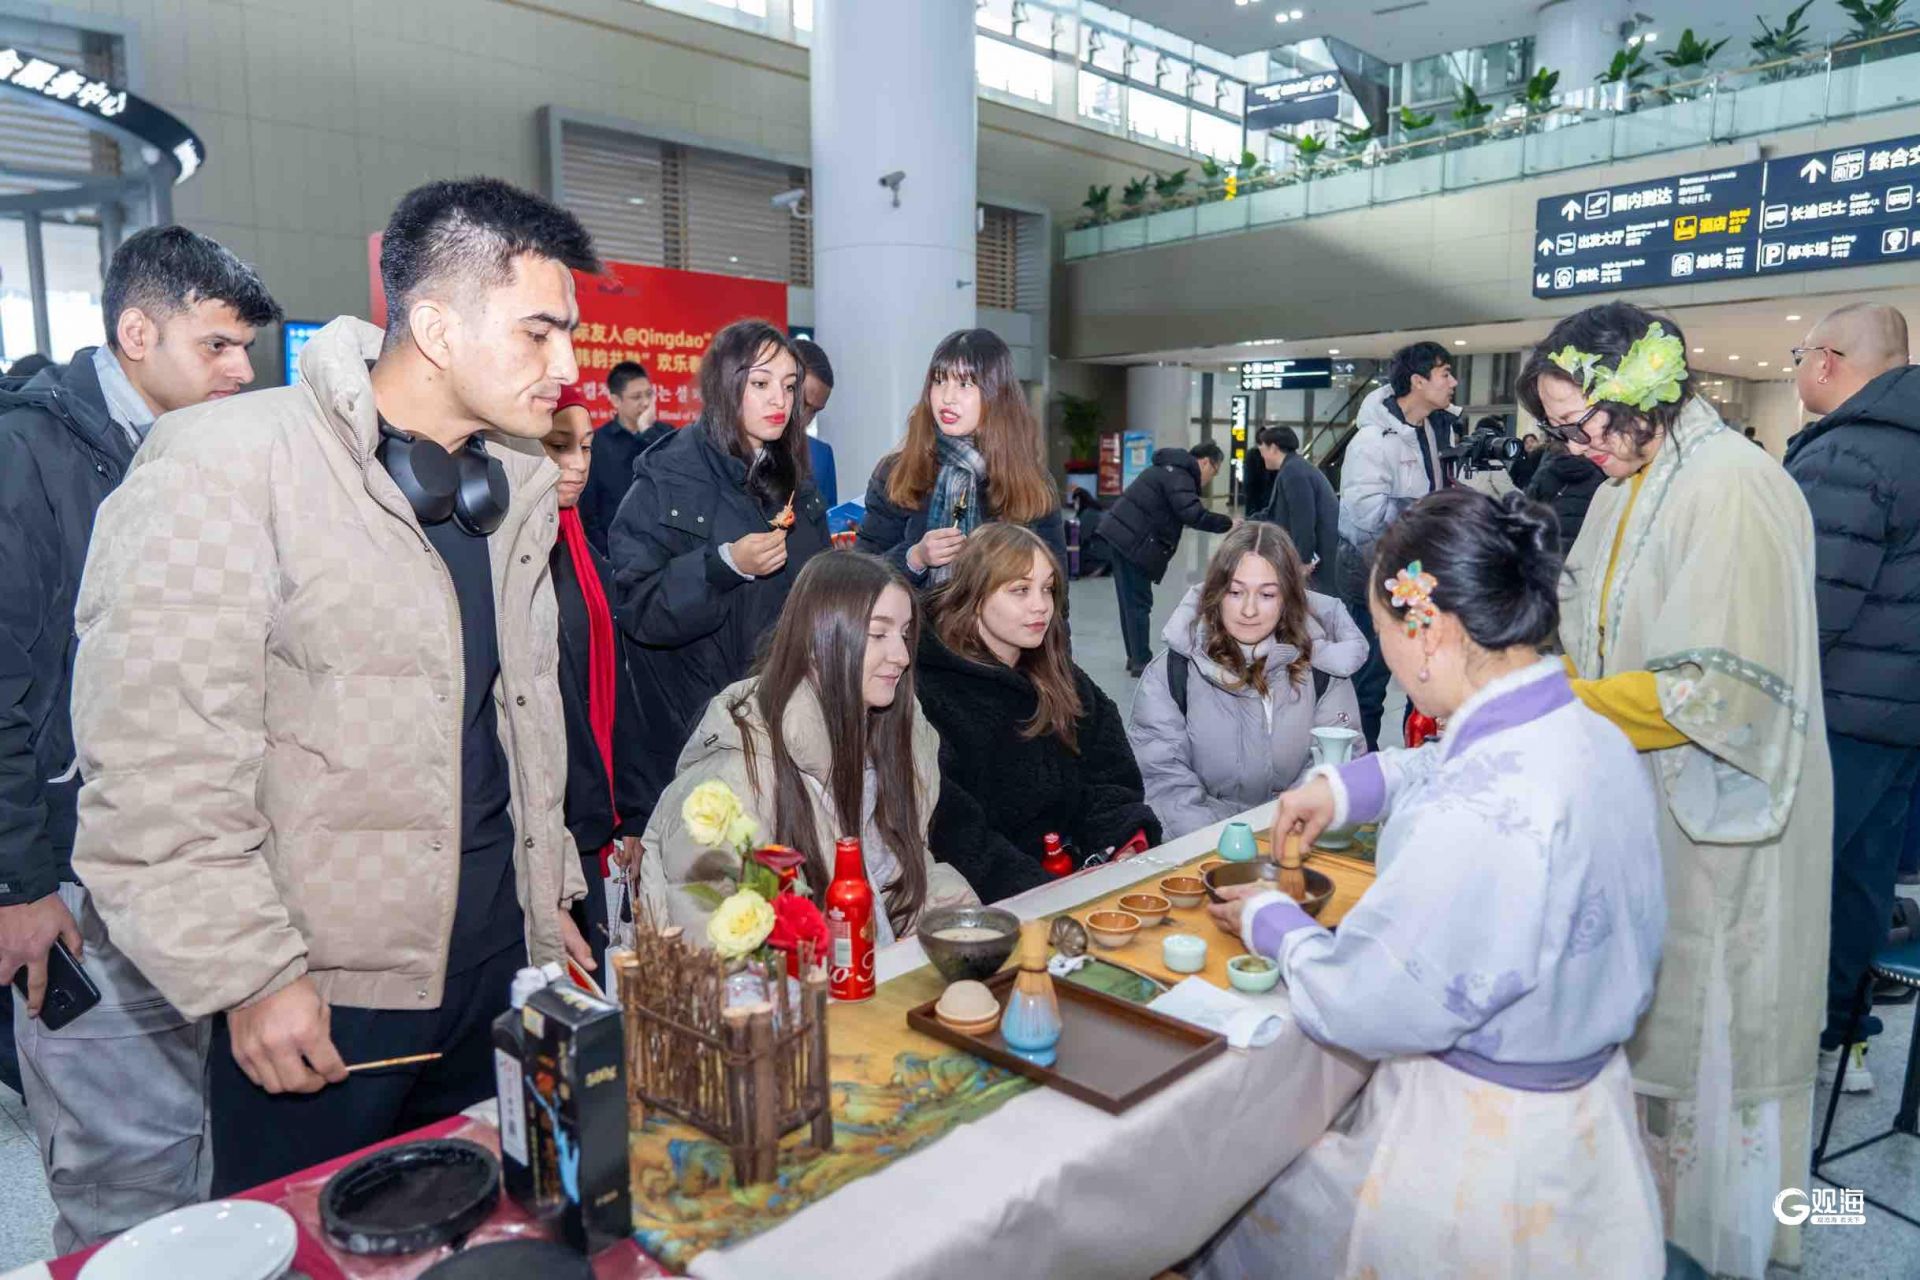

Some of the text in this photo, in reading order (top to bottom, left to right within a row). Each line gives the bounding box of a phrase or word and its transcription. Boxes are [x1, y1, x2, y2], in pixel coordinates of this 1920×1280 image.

[1612, 186, 1673, 213] 国内到达
[1699, 216, 1728, 234] 酒店
[1577, 229, 1625, 249] 出发大厅
[1787, 241, 1829, 260] 停车场
